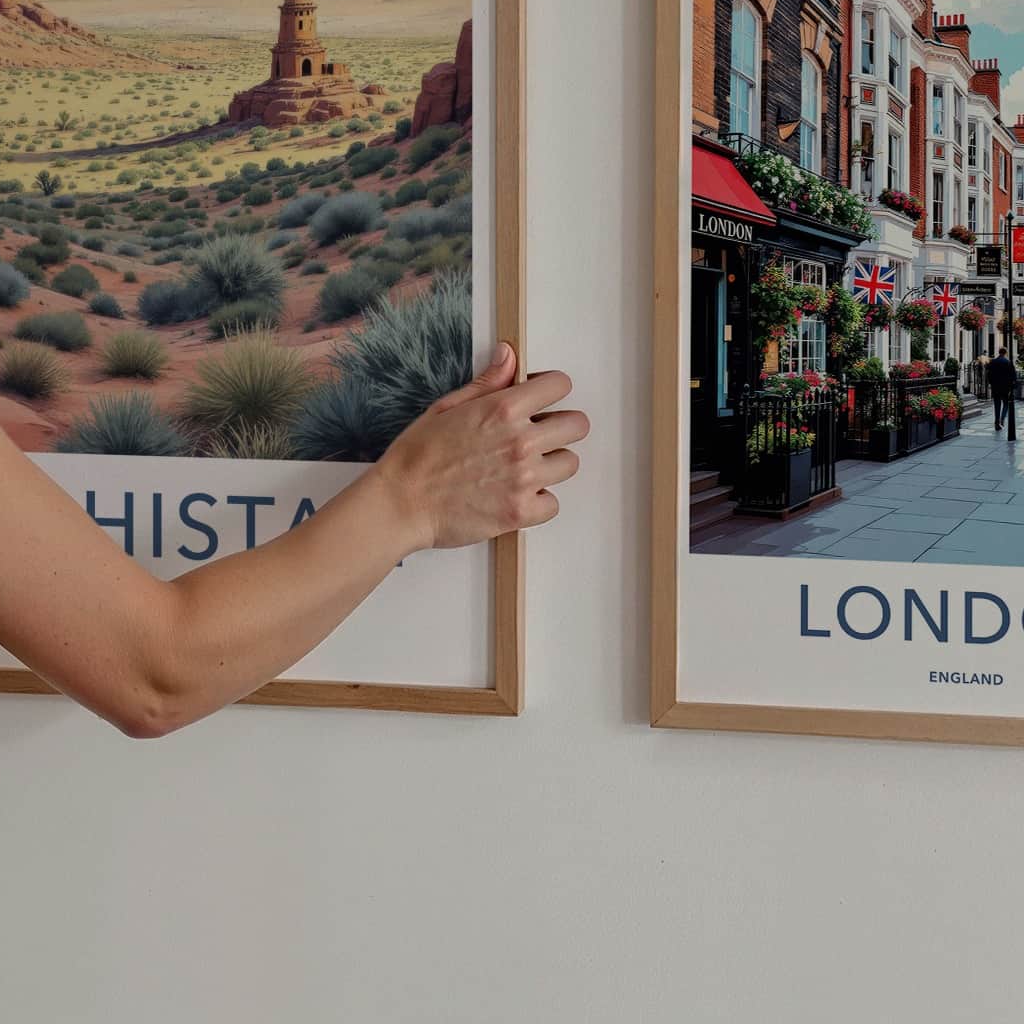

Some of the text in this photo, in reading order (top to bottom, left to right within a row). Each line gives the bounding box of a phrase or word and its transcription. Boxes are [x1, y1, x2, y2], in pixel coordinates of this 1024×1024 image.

[699, 214, 753, 242] LONDON
[800, 584, 1024, 645] LOND
[928, 671, 1004, 686] ENGLAND
